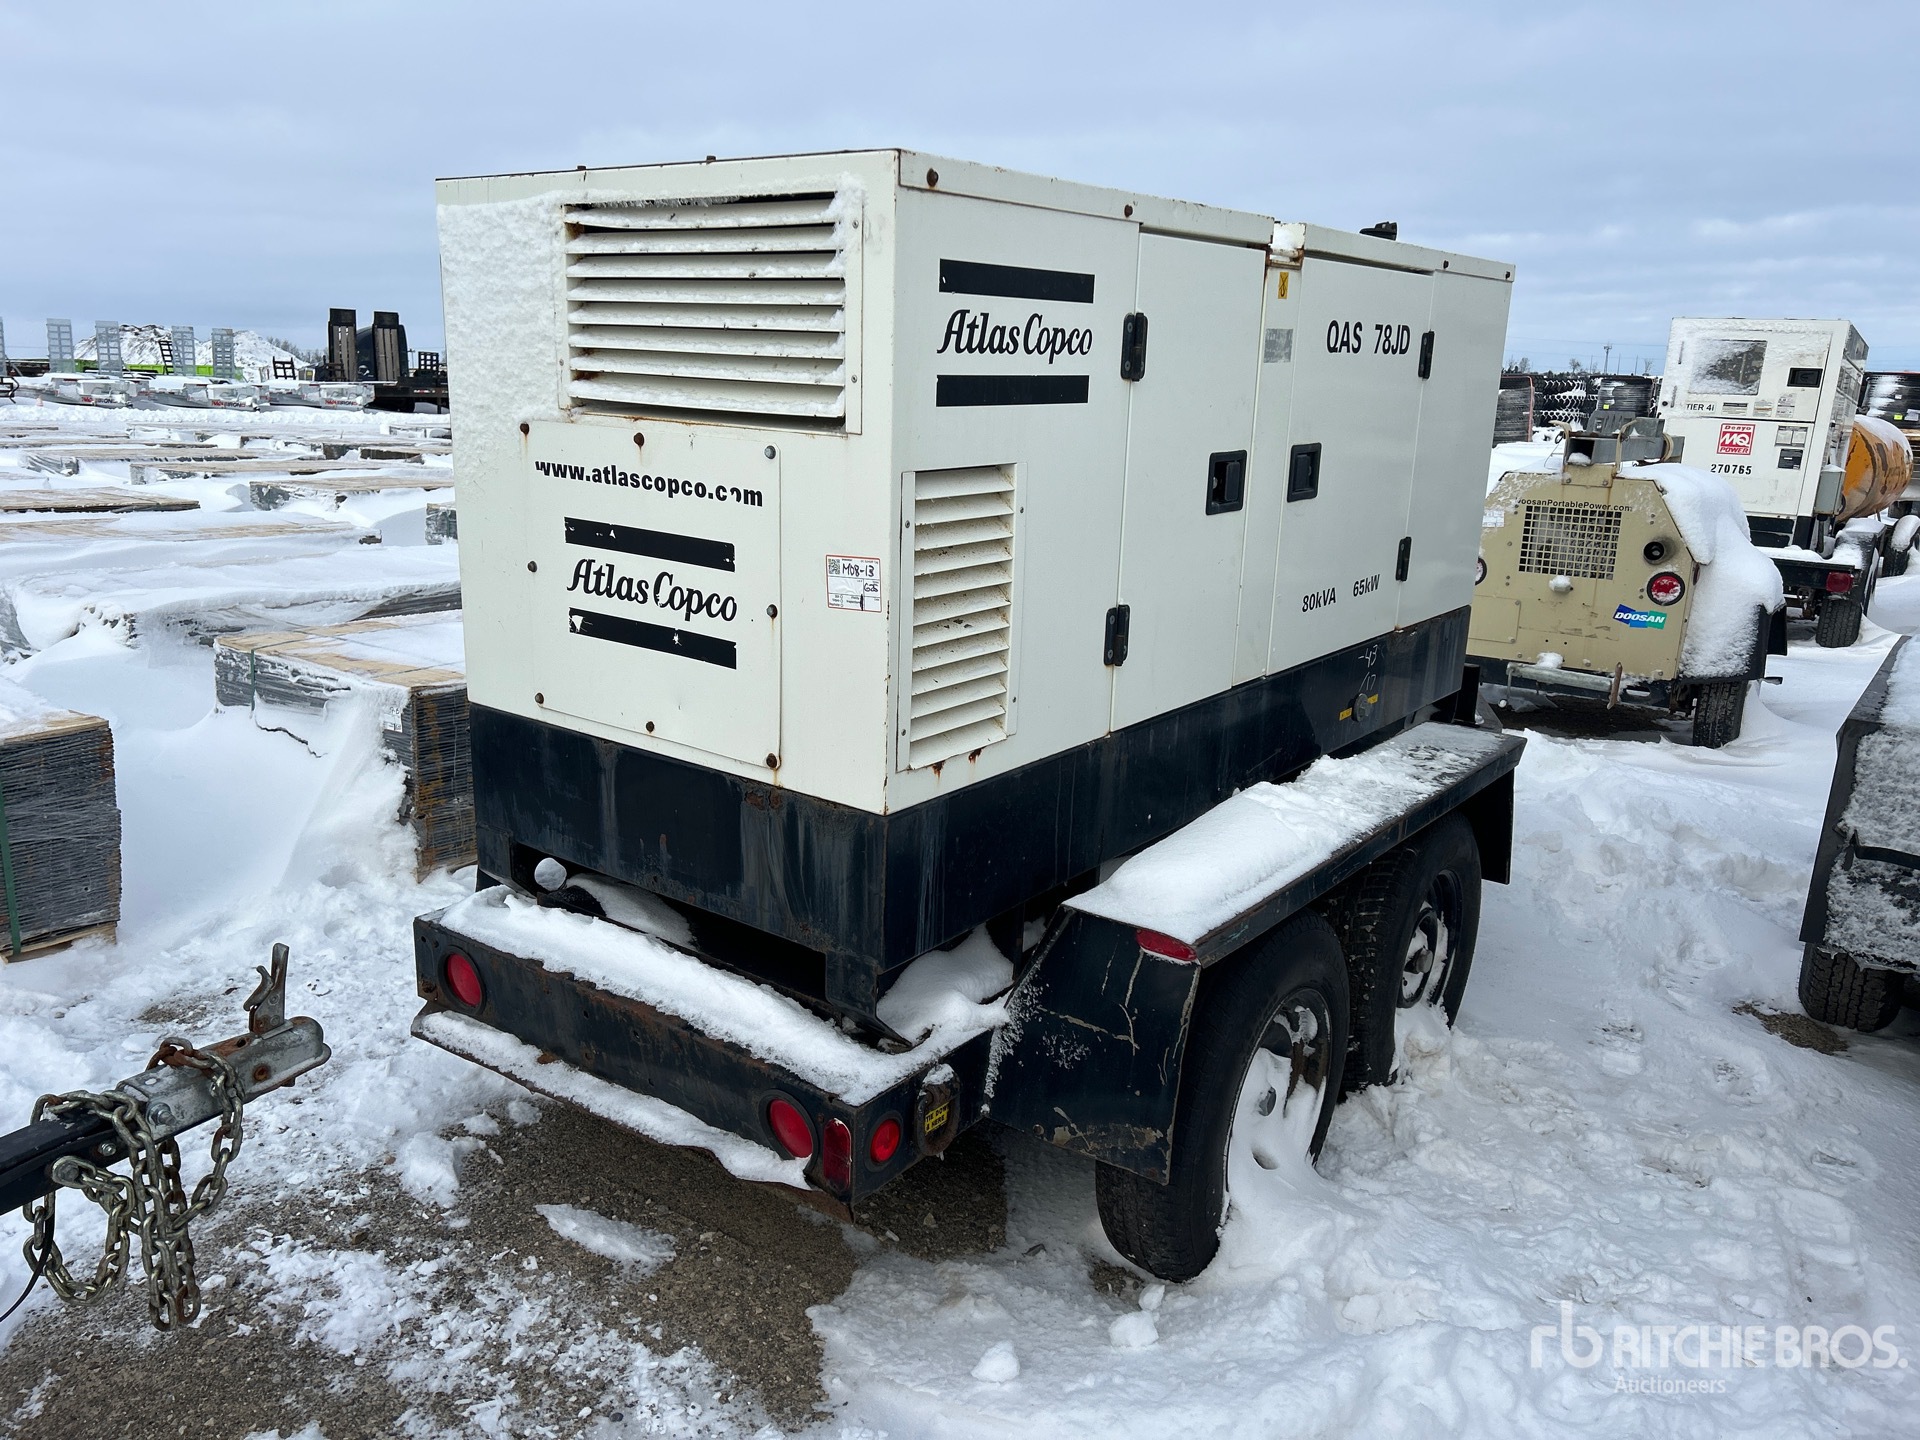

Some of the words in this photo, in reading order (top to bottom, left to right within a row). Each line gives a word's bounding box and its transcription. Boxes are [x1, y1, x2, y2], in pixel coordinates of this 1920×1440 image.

[937, 309, 1020, 355] Atlas
[1023, 313, 1093, 364] Copco
[1326, 320, 1363, 354] QAS
[1374, 324, 1411, 355] 78JD
[1686, 403, 1704, 411] TIER
[1720, 432, 1750, 447] MQ
[1710, 463, 1752, 475] 270765
[1517, 498, 1633, 512] oosanPortablePower.com
[842, 562, 875, 578] M08-13
[566, 557, 649, 604] Atlas
[652, 571, 737, 621] Copco
[1301, 587, 1337, 613] 80kVA
[1353, 573, 1381, 597] 65kW
[1614, 611, 1666, 624] DOOSAN
